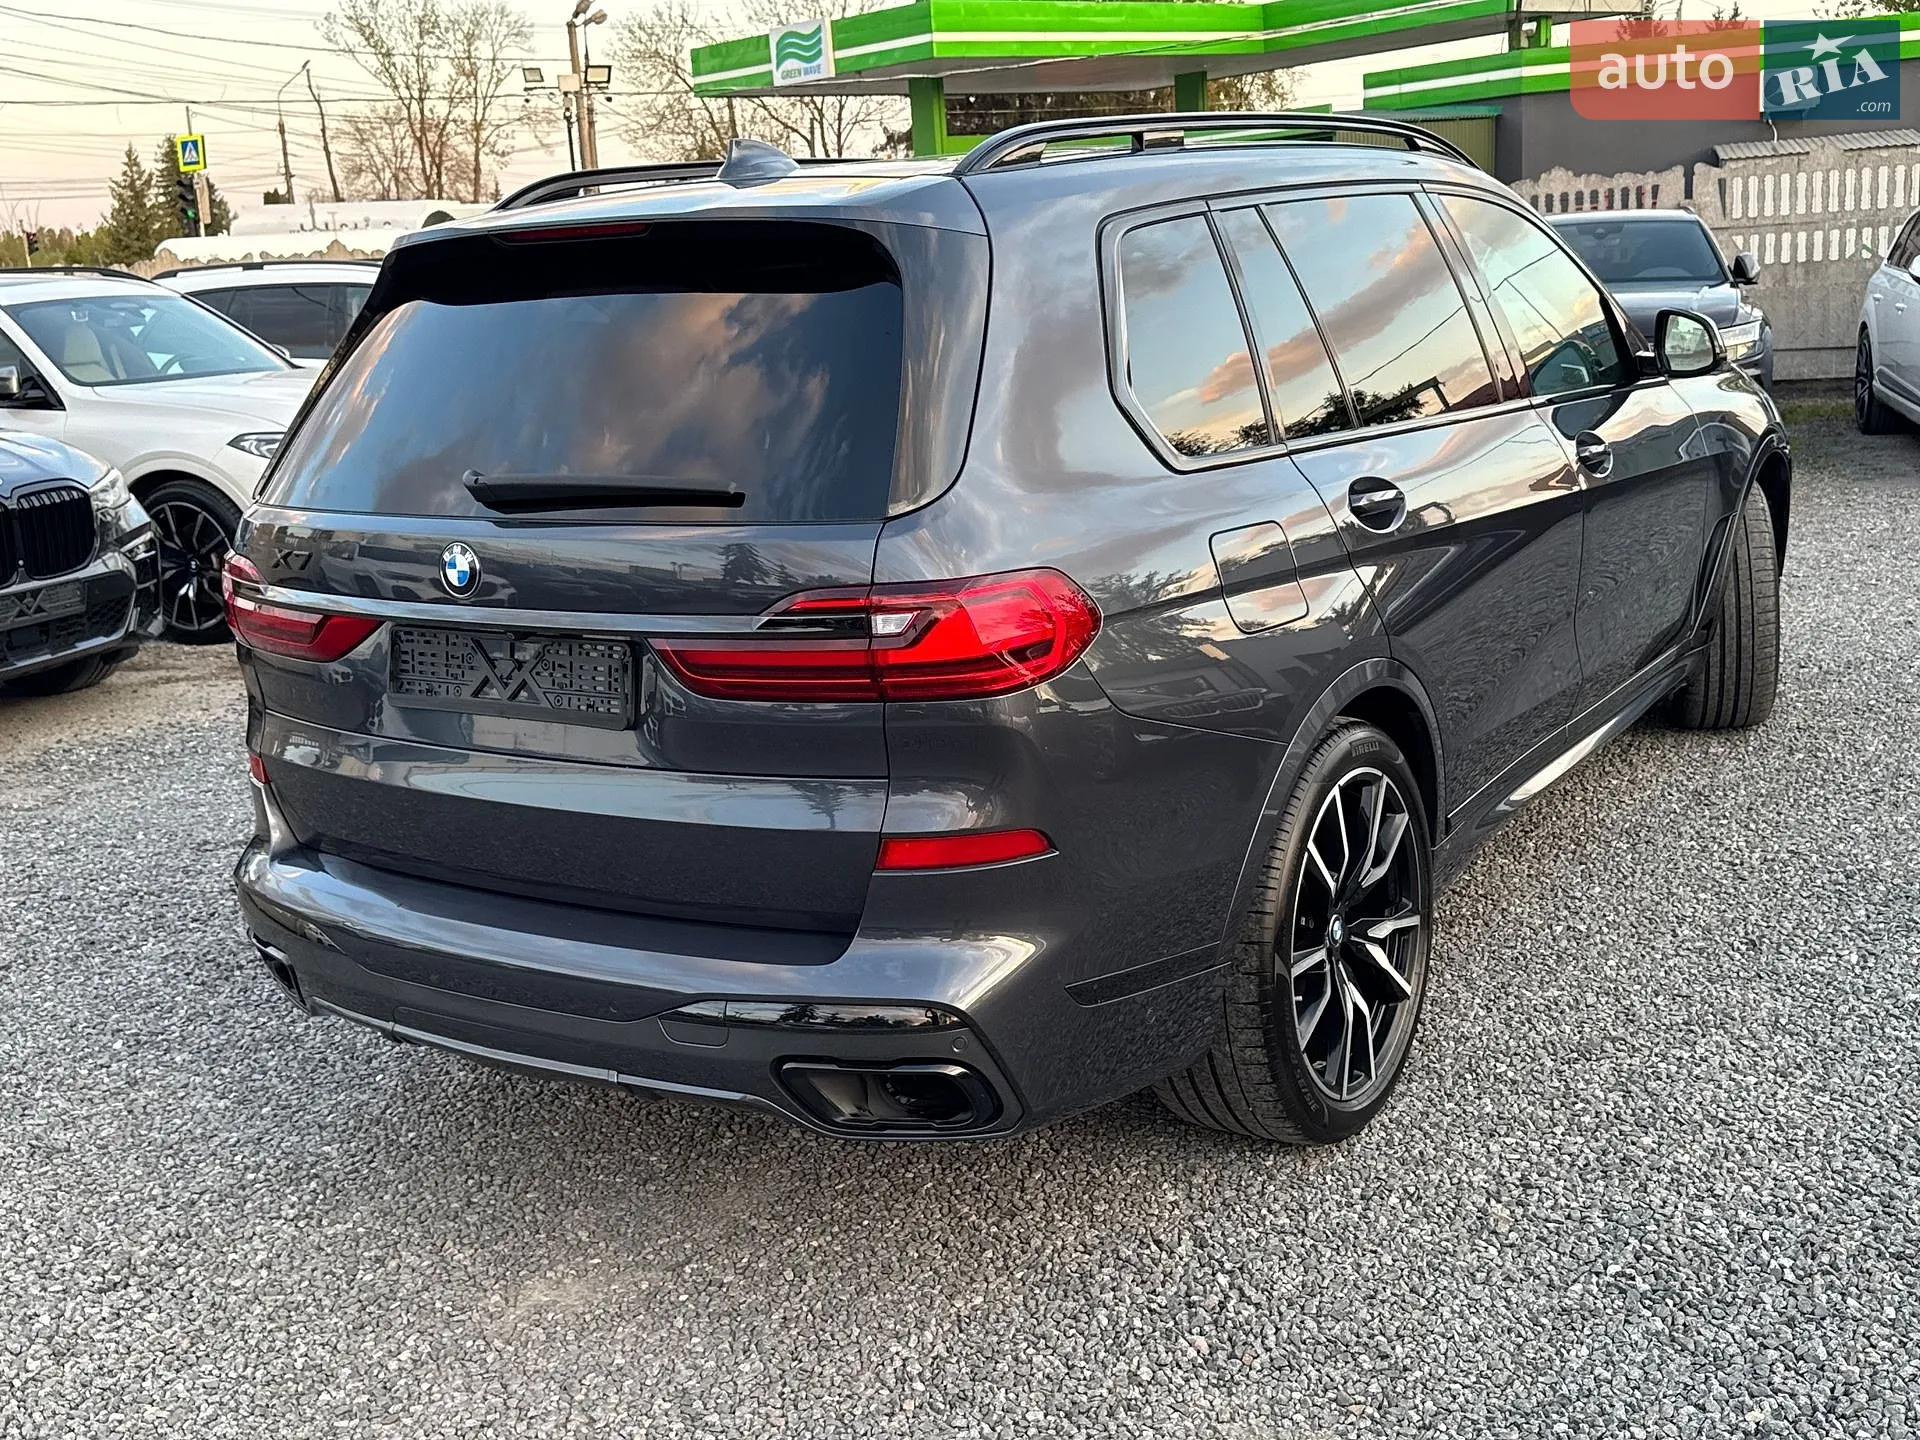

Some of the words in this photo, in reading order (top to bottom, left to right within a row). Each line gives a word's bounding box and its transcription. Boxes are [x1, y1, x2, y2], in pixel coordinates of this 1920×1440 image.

[780, 68, 802, 80] GREEN
[802, 63, 822, 77] WAVE
[271, 548, 314, 571] X7
[442, 543, 475, 563] BMW
